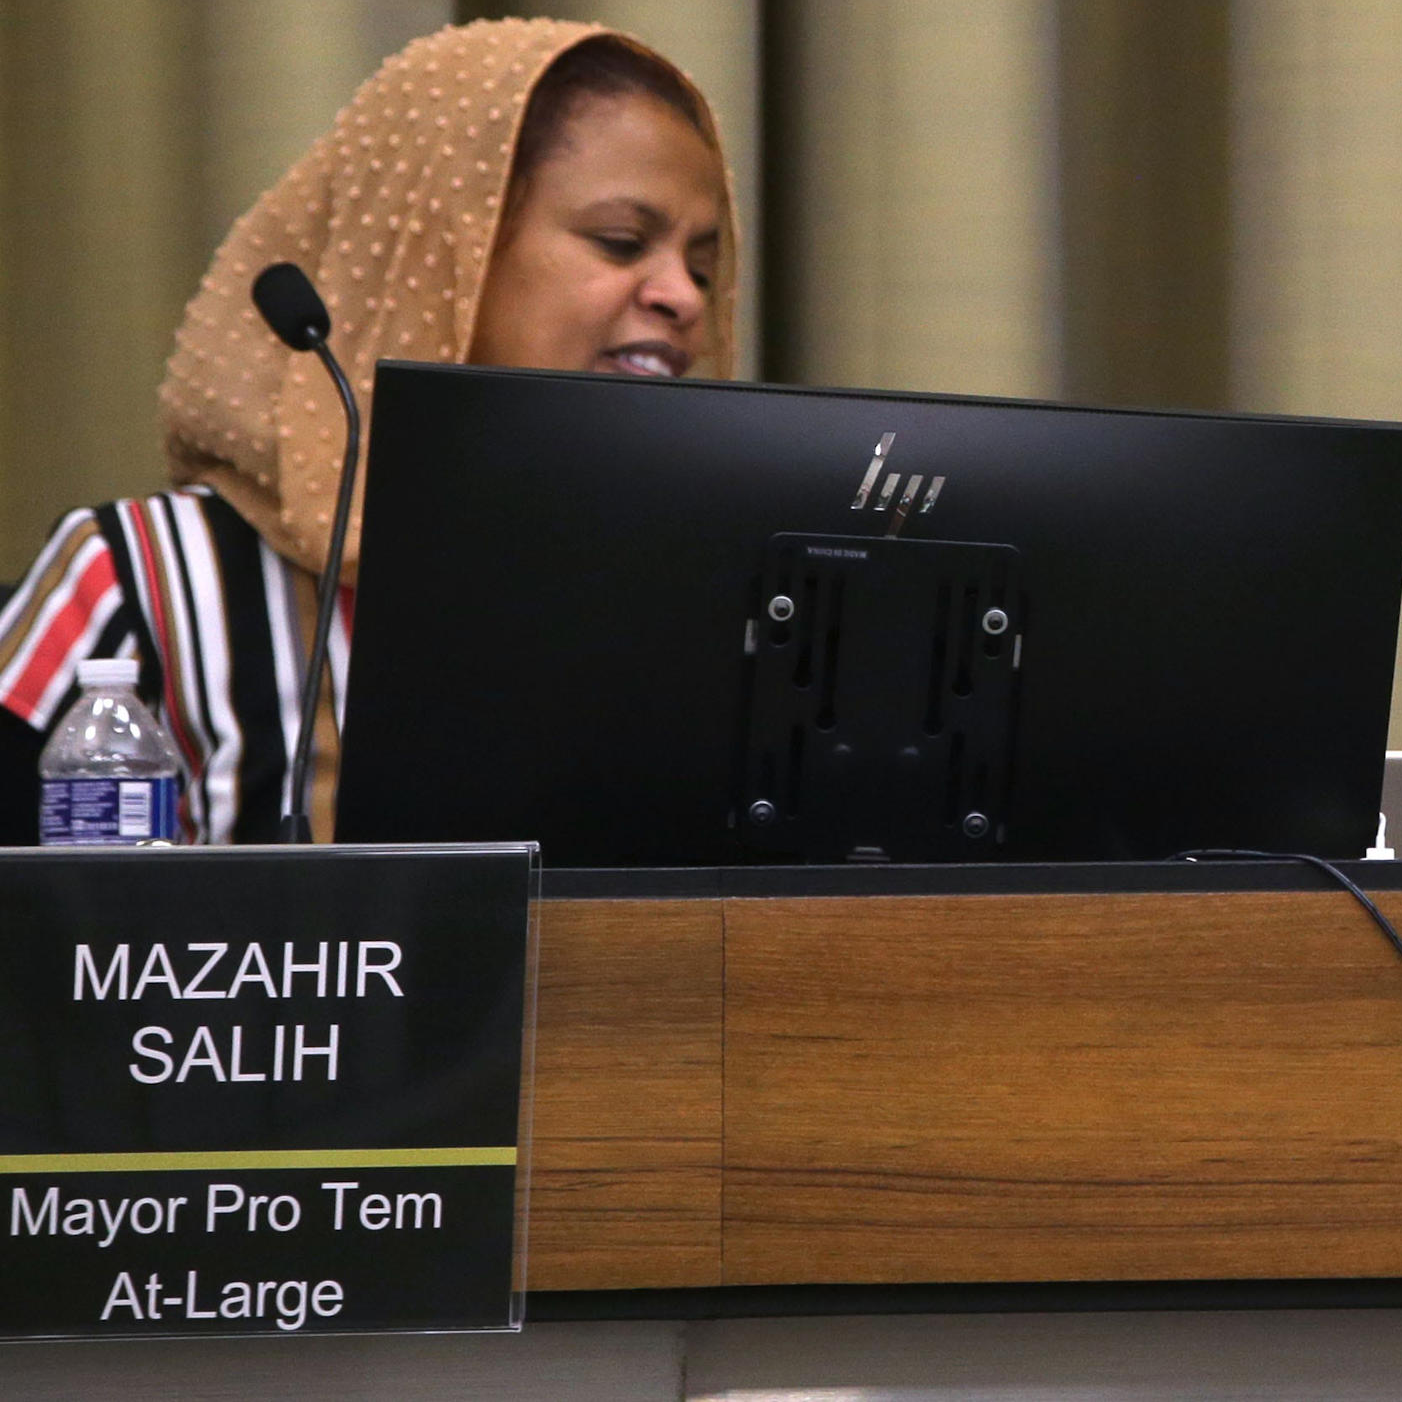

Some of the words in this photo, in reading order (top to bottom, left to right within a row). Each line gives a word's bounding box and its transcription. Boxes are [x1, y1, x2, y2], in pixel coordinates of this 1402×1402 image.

[73, 940, 404, 1002] MAZAHIR
[128, 1023, 340, 1085] SALIH
[10, 1186, 188, 1248] Mayor
[206, 1183, 302, 1234] Pro
[321, 1181, 443, 1232] Tem
[100, 1270, 345, 1332] At-Large
